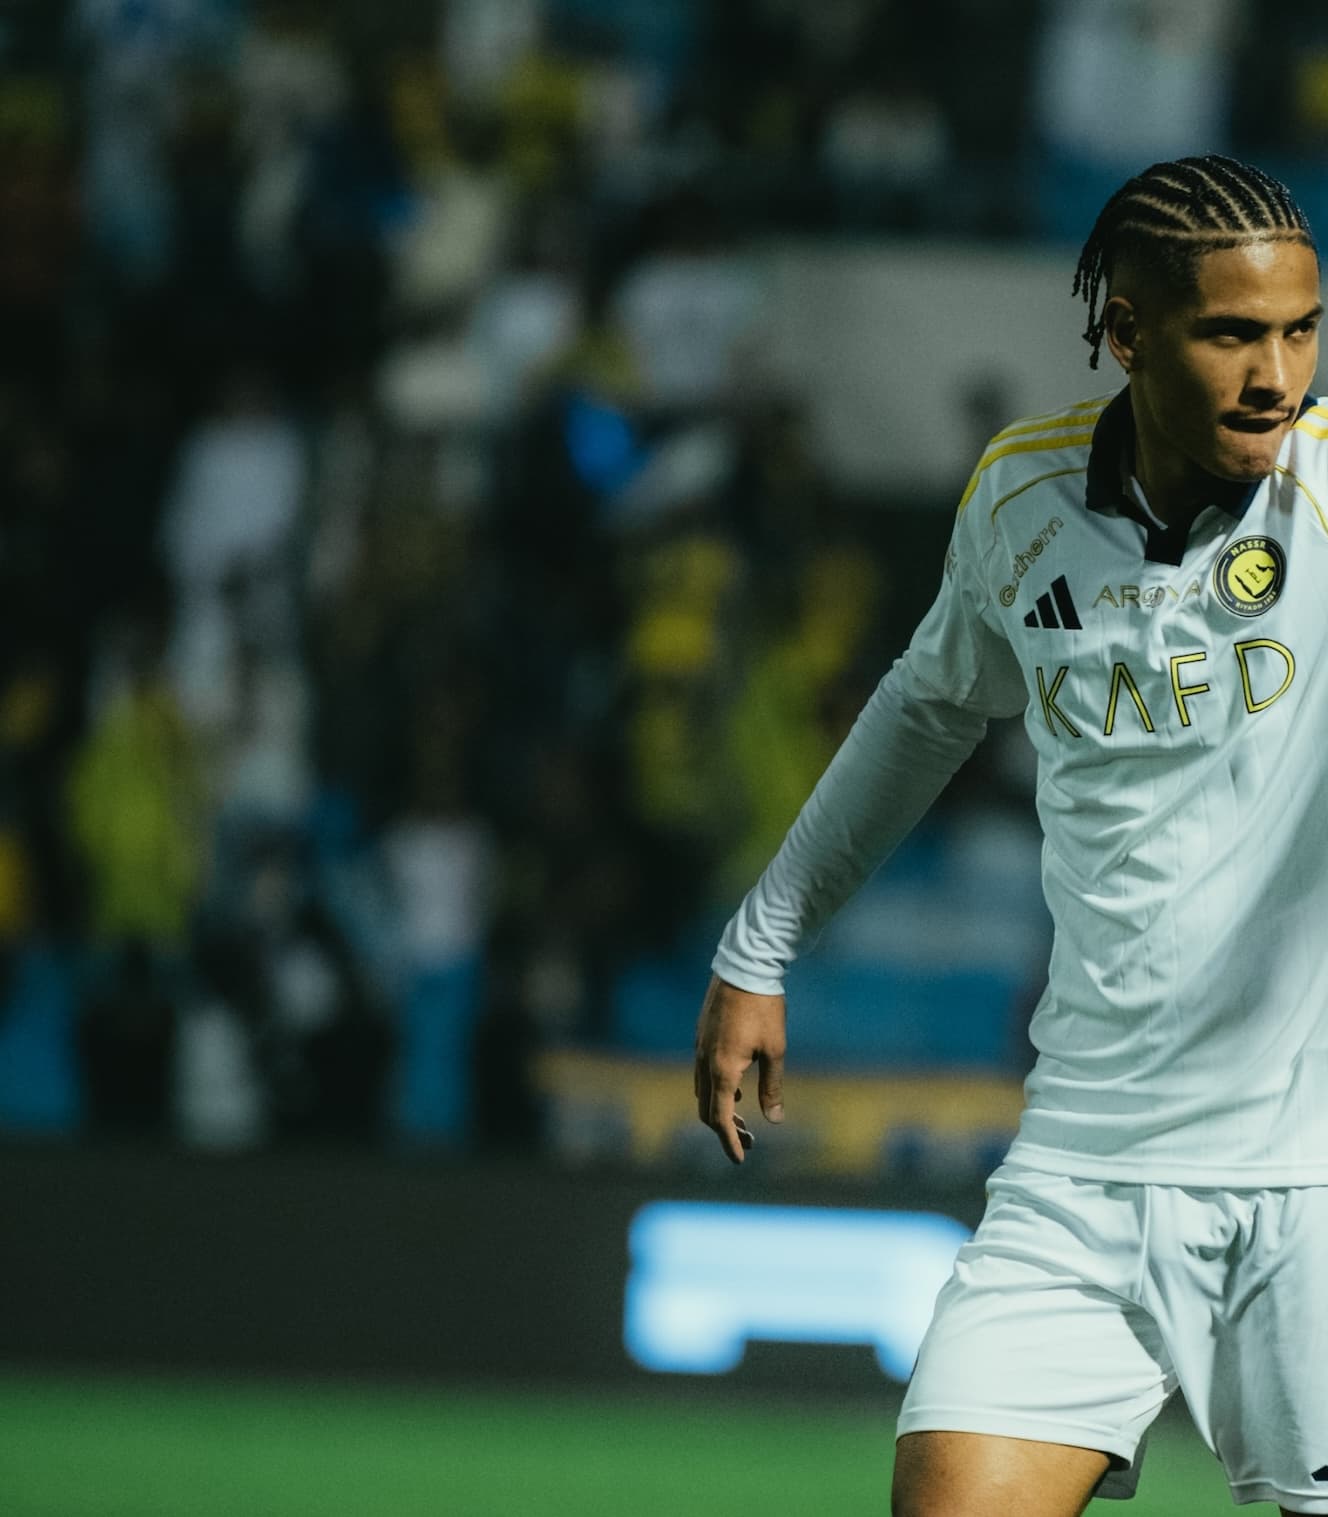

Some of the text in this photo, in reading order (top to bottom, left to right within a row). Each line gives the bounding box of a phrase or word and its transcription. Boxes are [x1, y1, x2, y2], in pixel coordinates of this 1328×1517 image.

[999, 515, 1065, 608] Gthern
[1230, 540, 1267, 557] NASSR
[1036, 638, 1296, 738] KAFD
